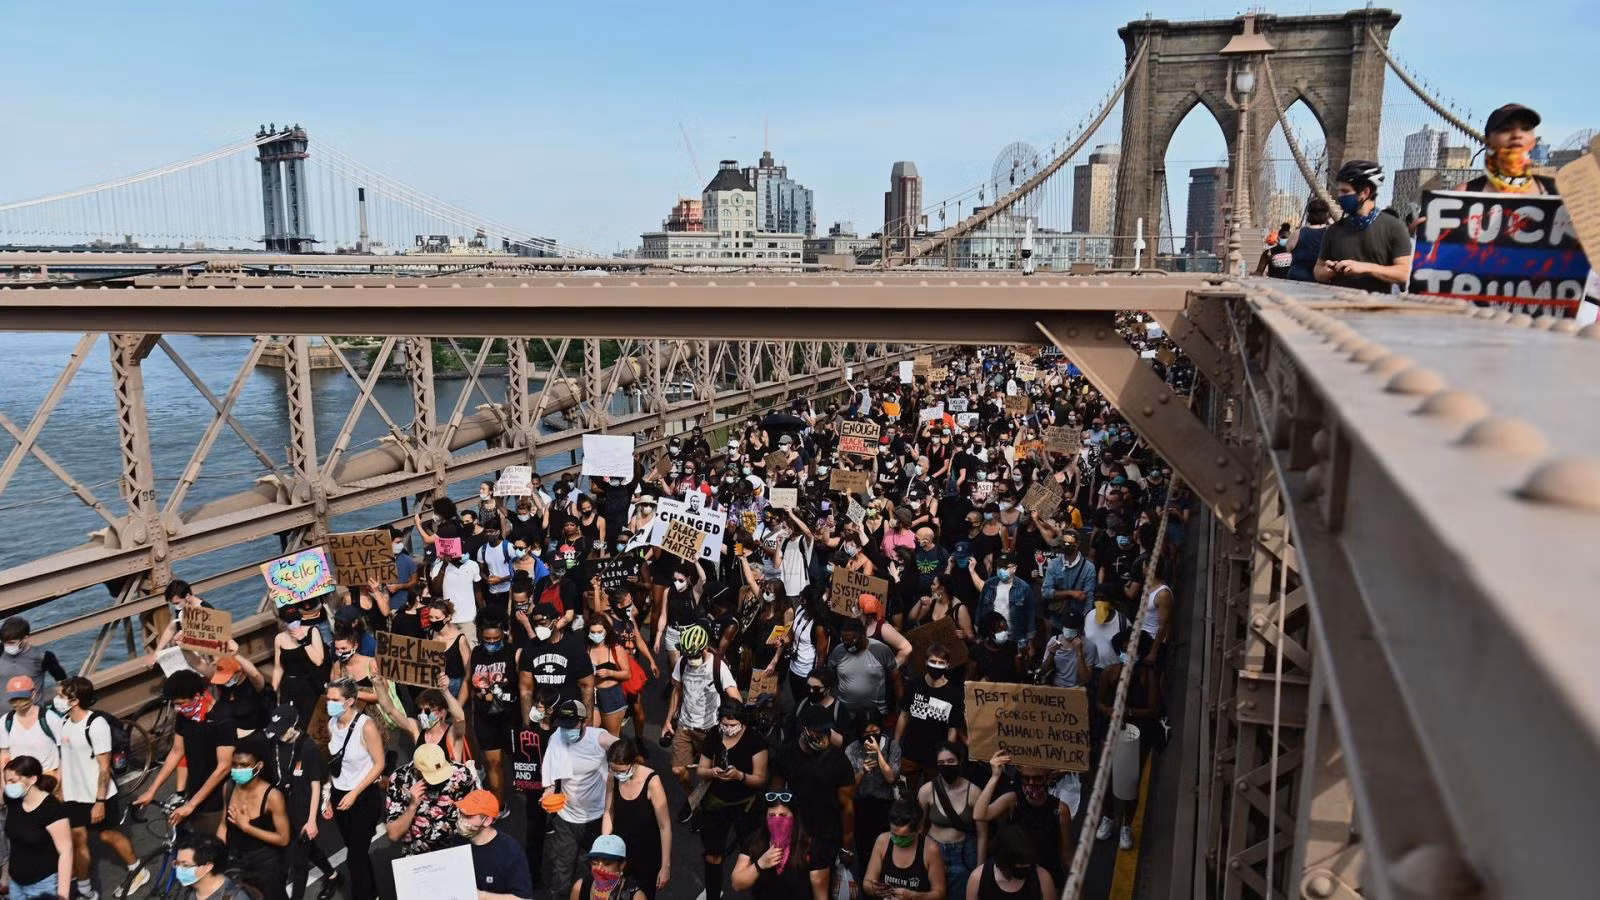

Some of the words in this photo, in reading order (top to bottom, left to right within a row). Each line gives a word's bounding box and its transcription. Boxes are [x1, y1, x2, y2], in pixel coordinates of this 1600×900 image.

[1414, 268, 1583, 318] TRUMP
[842, 422, 879, 435] ENOUGH
[840, 436, 863, 446] BLACK
[842, 445, 868, 453] MATTER
[666, 529, 696, 548] LIVES
[672, 522, 700, 538] BLACK
[328, 533, 386, 549] BLACK
[662, 539, 698, 560] MATTER
[278, 559, 297, 570] be
[333, 548, 396, 567] LIVES
[597, 560, 623, 569] STOP
[271, 560, 328, 586] excellent
[336, 564, 398, 584] MATTER
[847, 570, 870, 587] END
[604, 579, 621, 588] US!!
[278, 590, 307, 604] each
[376, 632, 416, 660] Black
[417, 639, 446, 667] Lives
[380, 656, 442, 688] MATTER
[914, 692, 928, 701] UN-
[974, 688, 1009, 707] REST
[1022, 688, 1066, 710] POWER
[994, 707, 1036, 721] GEORGE
[1040, 711, 1078, 726] FLOYD
[997, 721, 1044, 738] AHMAUD
[1048, 726, 1090, 748] ARBERY
[1041, 743, 1086, 766] TAYLOR
[513, 762, 538, 772] RESIST
[515, 771, 532, 780] AND
